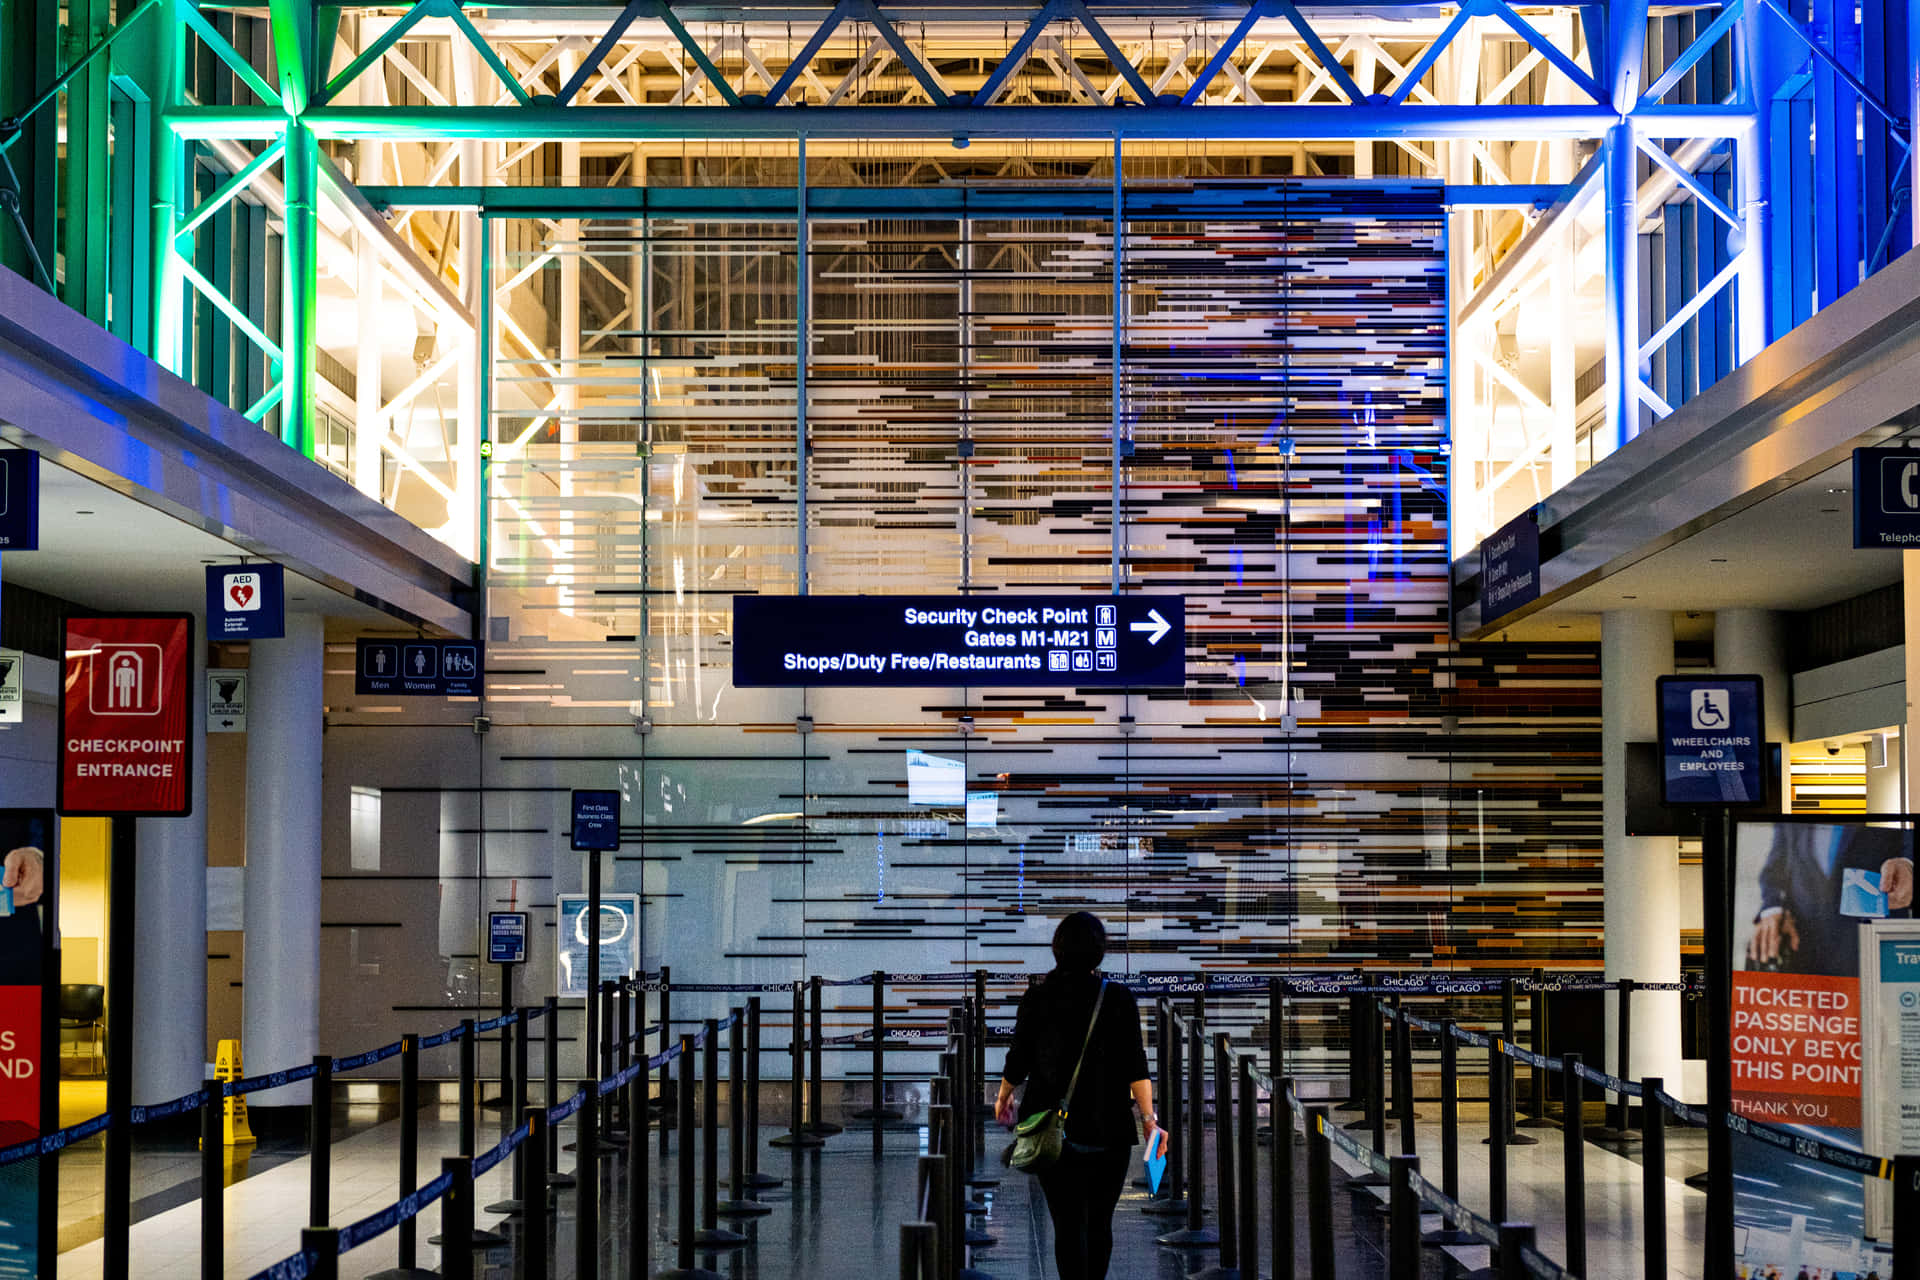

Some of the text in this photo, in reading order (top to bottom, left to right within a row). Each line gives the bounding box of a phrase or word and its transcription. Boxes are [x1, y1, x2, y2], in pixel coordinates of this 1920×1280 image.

[233, 576, 252, 584] AED
[905, 608, 1088, 627] Security Check Point
[965, 631, 1115, 647] Gates M1-M21 M
[784, 653, 1041, 672] Shops/Duty Free/Restaurants
[68, 739, 184, 753] CHECKPOINT
[1672, 737, 1751, 746] WHEELCHAIRS
[1700, 750, 1724, 759] AND
[77, 764, 173, 777] ENTRANCE
[1680, 762, 1745, 771] EMPLOYEES
[891, 974, 921, 982] CHICAGO
[1147, 976, 1178, 985] CHICAGO
[1212, 975, 1253, 983] CHICAGO
[1383, 978, 1423, 986] CHICAGO
[625, 984, 669, 992] CHICAGO
[1169, 983, 1204, 992] CHICAGO
[1296, 985, 1340, 993] CHICAGO
[1435, 985, 1480, 993] CHICAGO
[1523, 983, 1561, 991] CHICAGO
[1642, 983, 1687, 991] CHICAGO
[1735, 986, 1849, 1010] TICKETED
[1735, 1011, 1858, 1035] PASSENGE
[891, 1030, 921, 1038] CHICAGO
[1733, 1036, 1797, 1056] ONLY
[1732, 1060, 1862, 1084] THIS POINT
[1732, 1099, 1828, 1117] THANK YOU
[1727, 1113, 1748, 1134] CHICAGO
[41, 1130, 66, 1154] CHICAGO
[1796, 1138, 1820, 1159] CHICAGO
